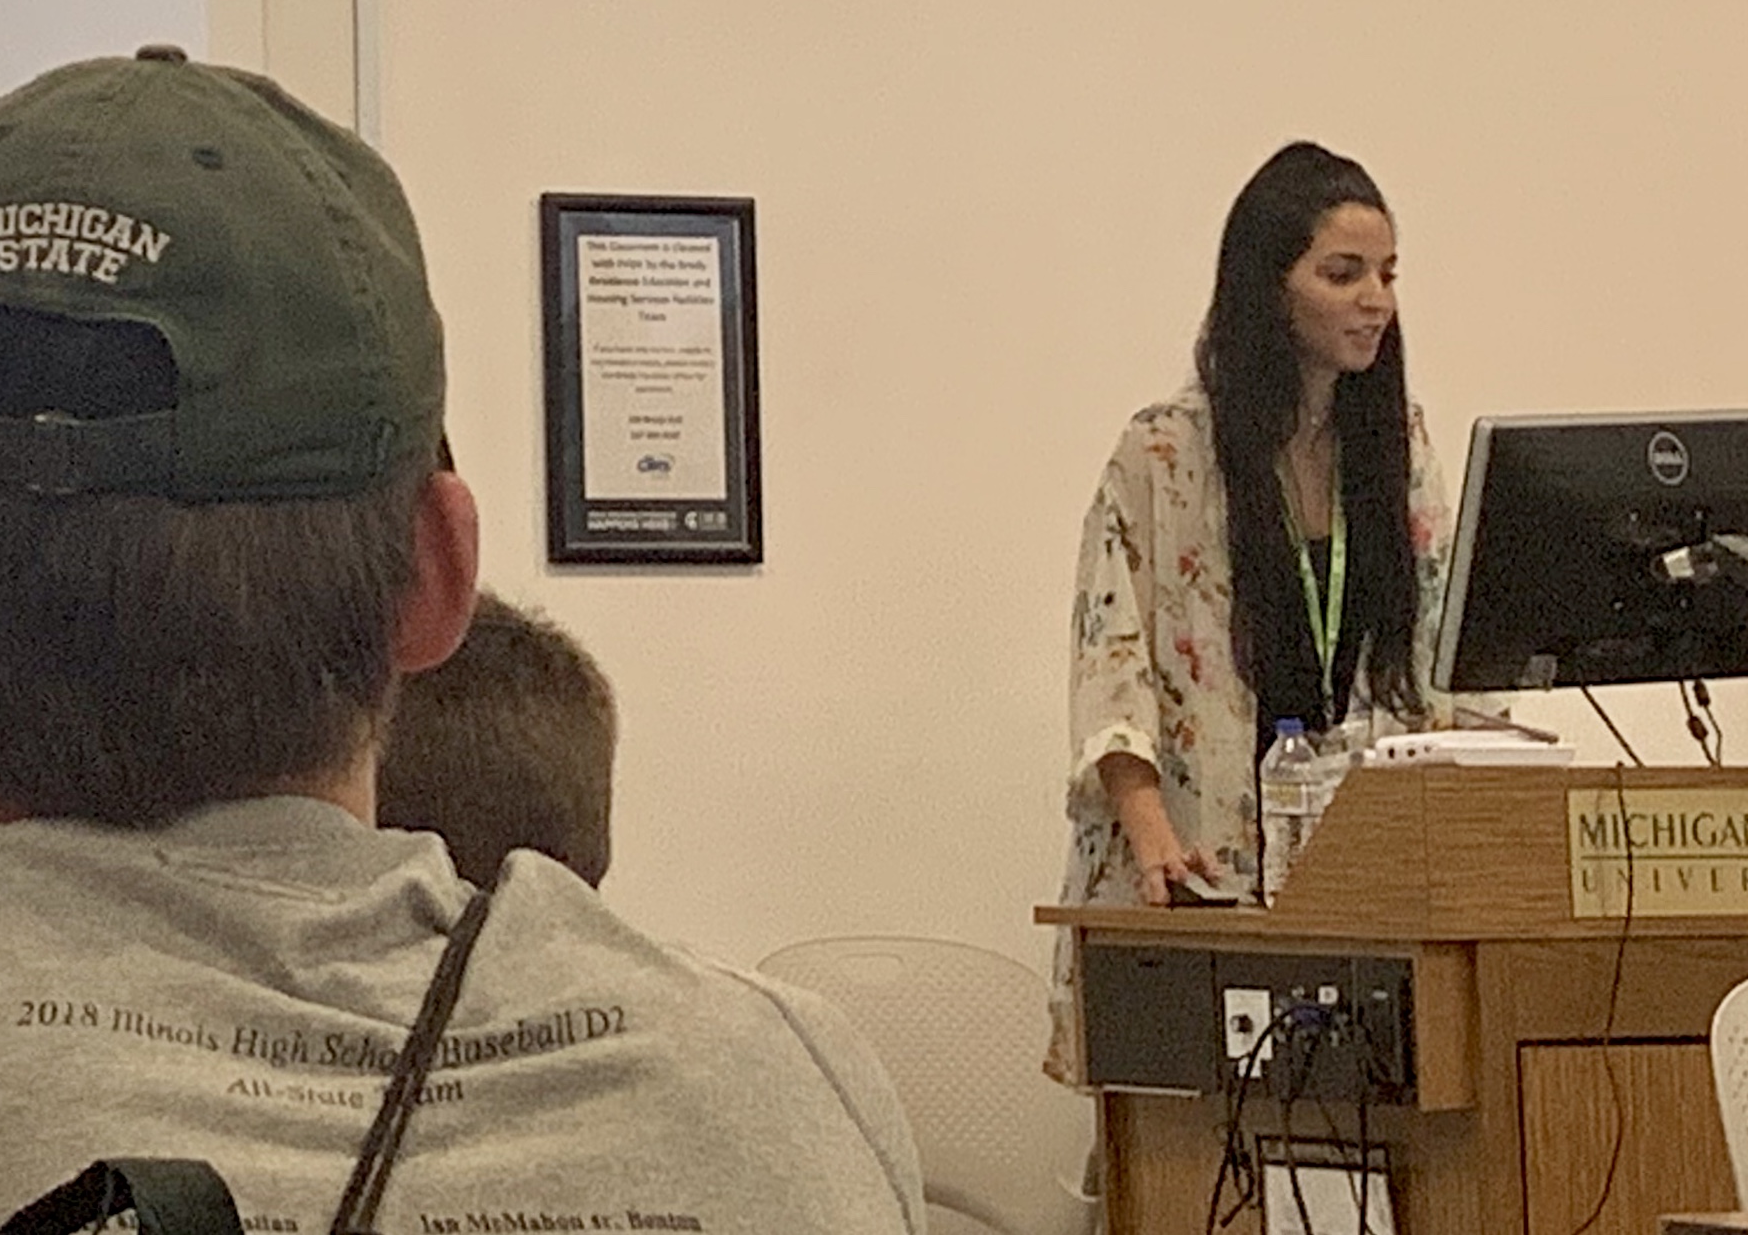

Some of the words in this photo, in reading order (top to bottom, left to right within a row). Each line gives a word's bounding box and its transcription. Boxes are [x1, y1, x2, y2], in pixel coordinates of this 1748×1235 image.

[16, 1000, 100, 1028] 2018
[111, 1007, 220, 1053] Illinois
[231, 1026, 309, 1068] High
[584, 1005, 628, 1041] D2
[226, 1077, 364, 1109] All-State
